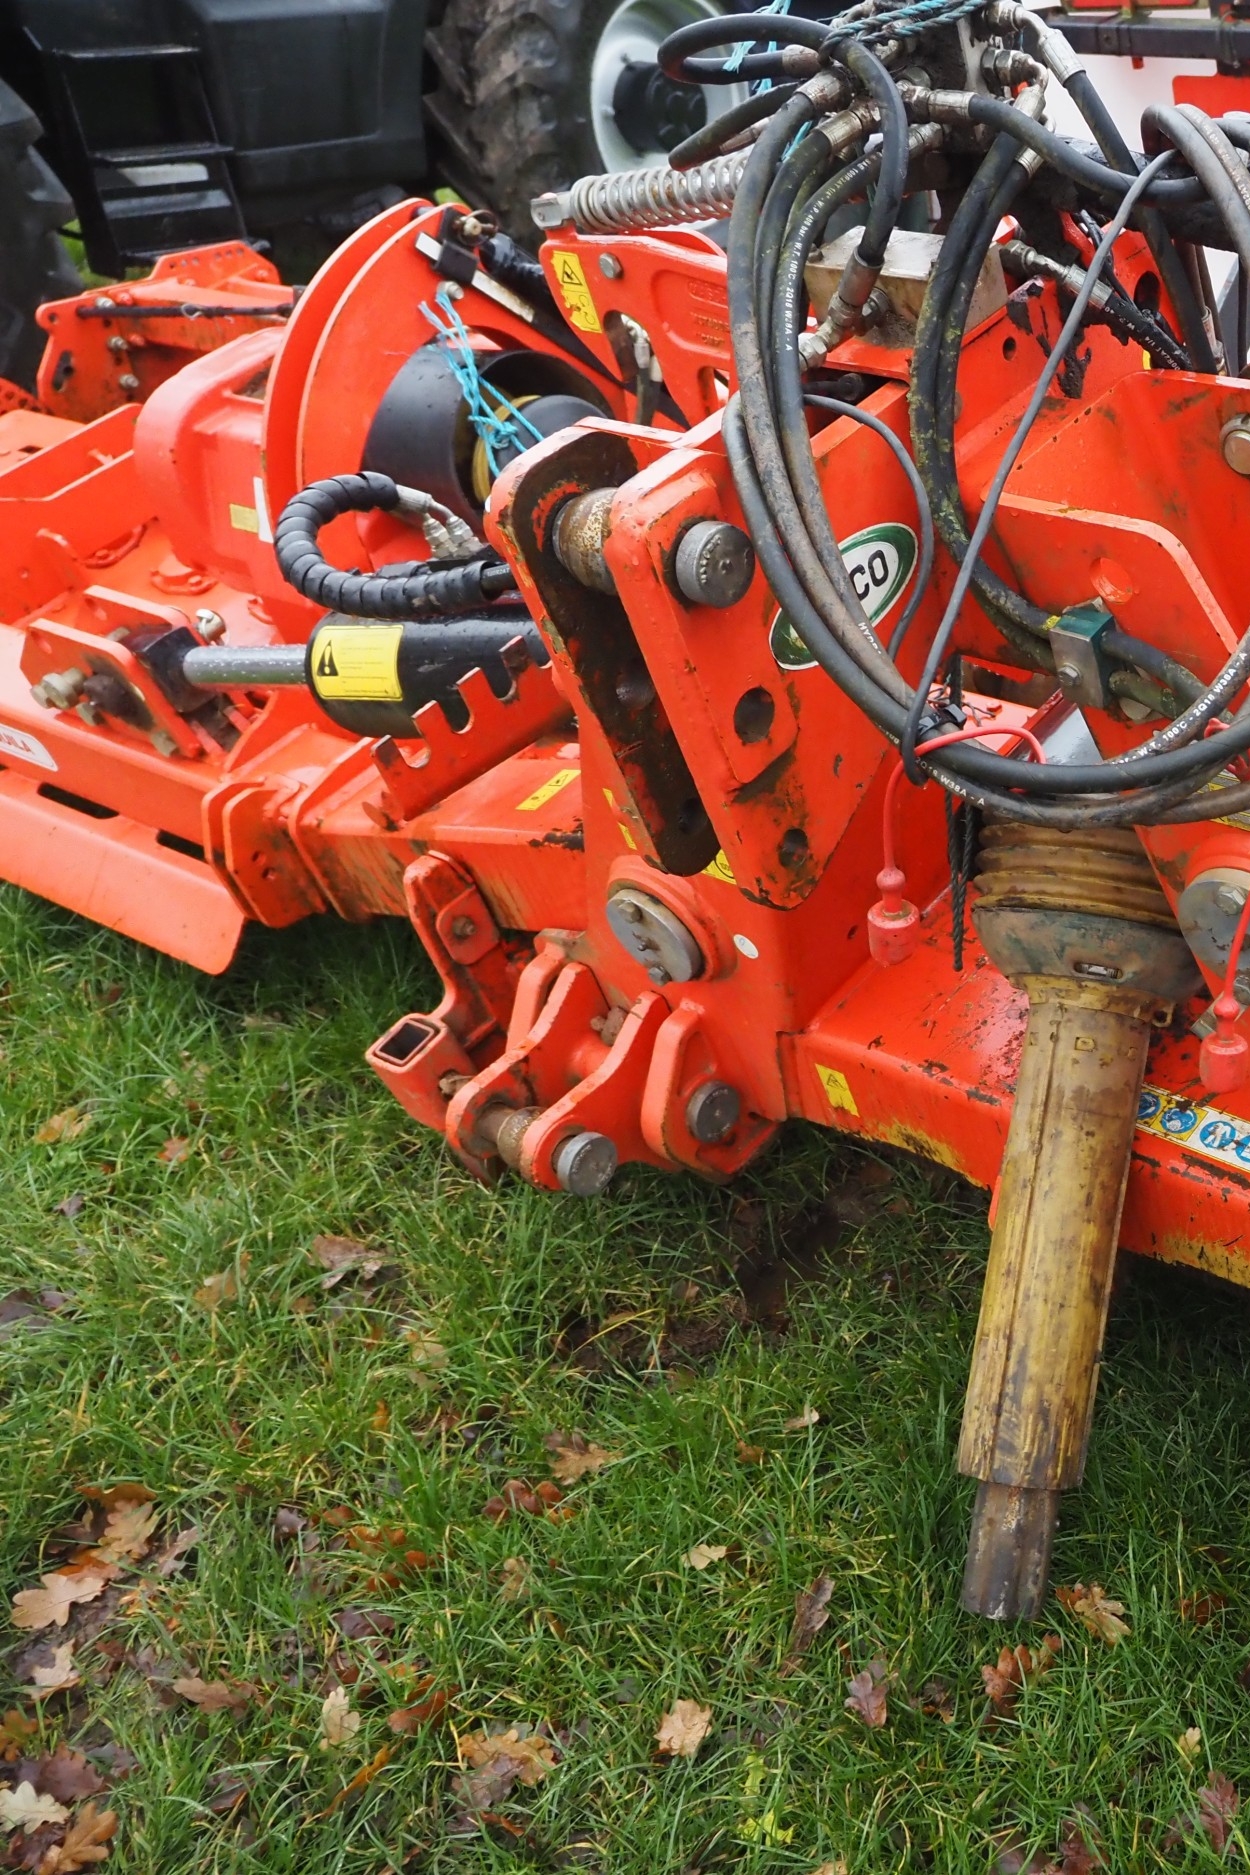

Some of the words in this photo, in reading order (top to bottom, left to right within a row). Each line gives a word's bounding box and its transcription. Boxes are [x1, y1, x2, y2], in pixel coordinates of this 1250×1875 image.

[785, 343, 793, 352] A
[1239, 652, 1248, 661] A
[940, 775, 967, 797] W38A
[977, 797, 985, 806] A
